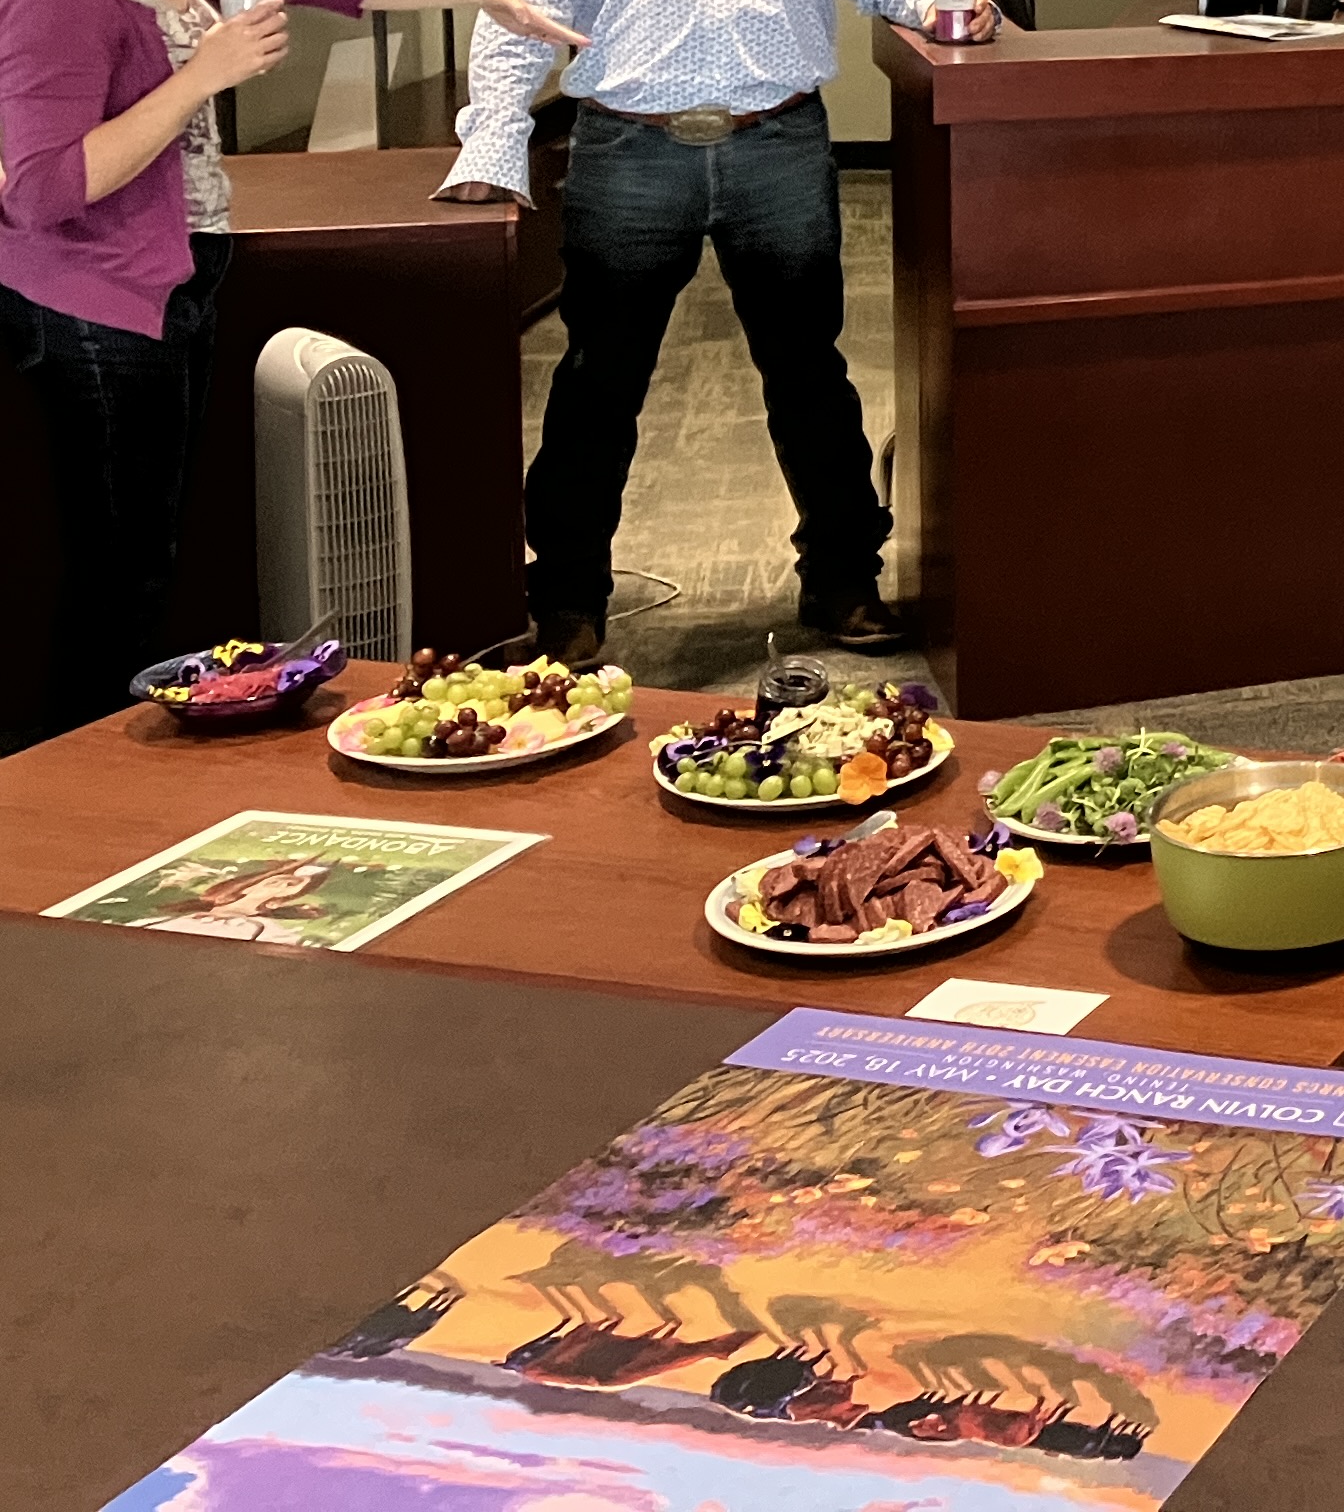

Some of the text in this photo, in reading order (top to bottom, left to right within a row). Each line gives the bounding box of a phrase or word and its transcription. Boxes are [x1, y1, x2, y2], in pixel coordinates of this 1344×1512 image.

[816, 1026, 956, 1050] ANNIVERSARY
[959, 1040, 1012, 1060] 20TH
[1015, 1048, 1128, 1071] EASEMENT
[943, 1055, 1087, 1078] WASHINGTON
[1131, 1061, 1288, 1092] CONSERVATION
[780, 1047, 1325, 1124] COLVIN RANCH DAY MAY 18, 2025
